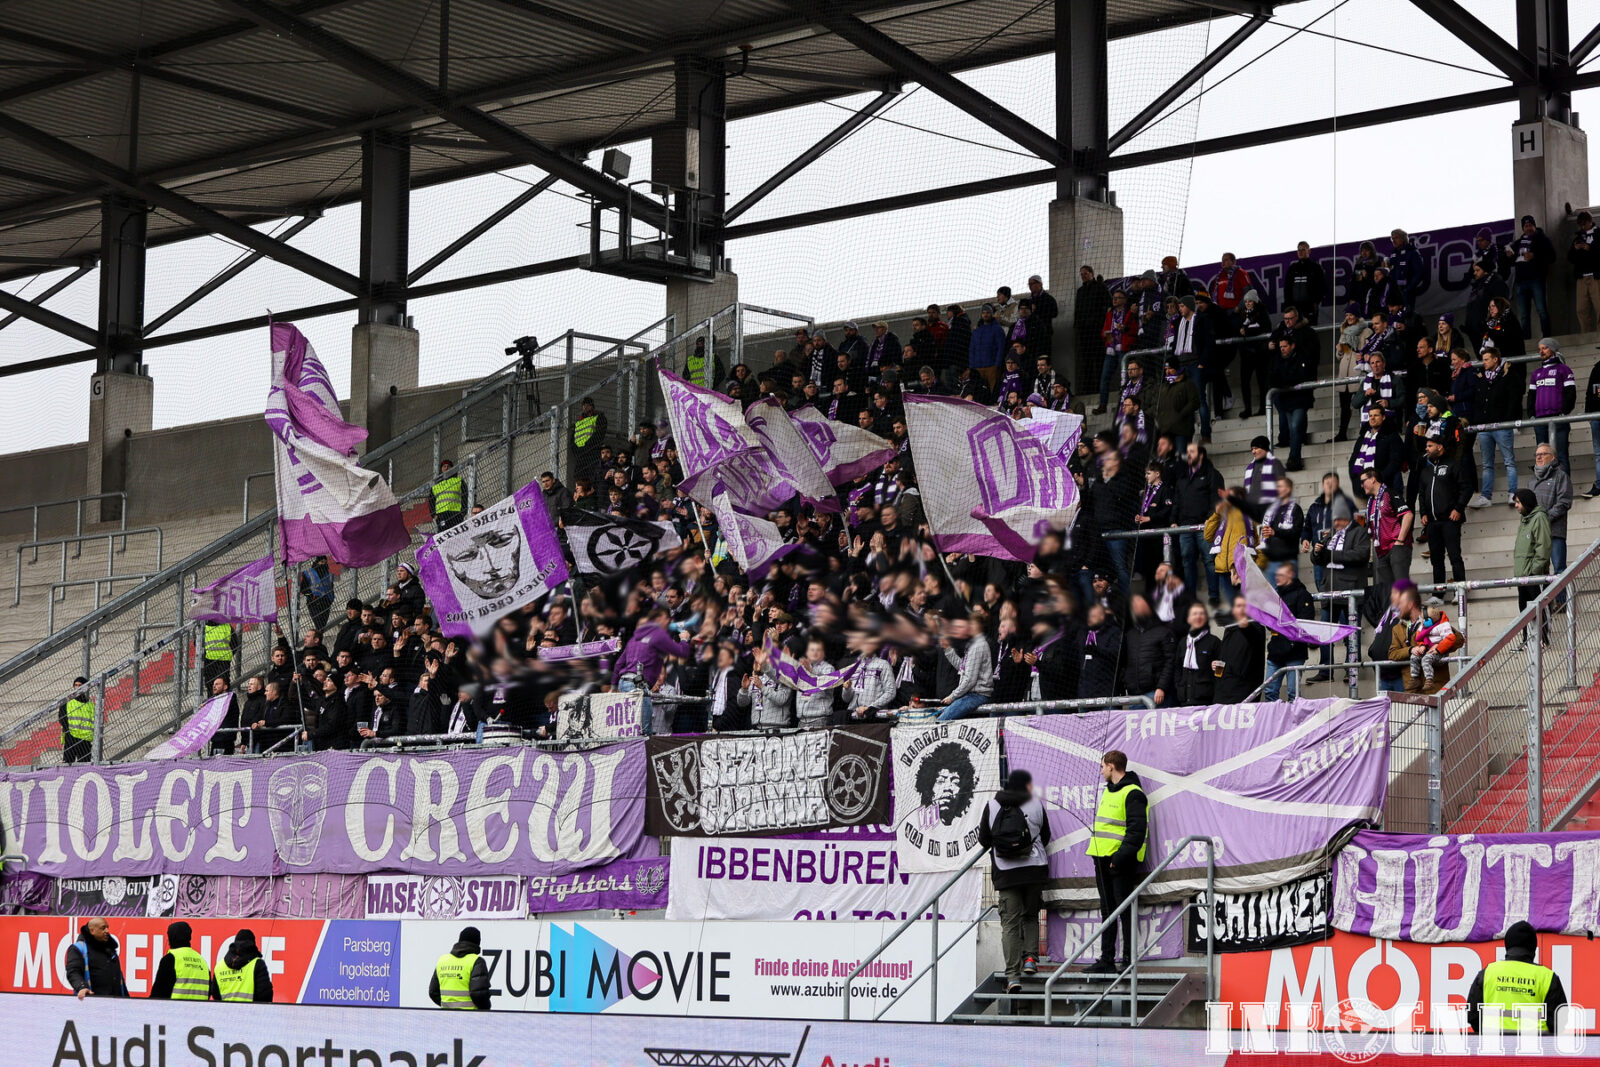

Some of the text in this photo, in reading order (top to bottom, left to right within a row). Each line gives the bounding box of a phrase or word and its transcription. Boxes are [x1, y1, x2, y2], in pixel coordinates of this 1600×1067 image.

[1520, 130, 1535, 152] H
[93, 380, 101, 395] G
[900, 724, 991, 766] PURPLE HAZE
[1283, 721, 1387, 784] BRÜCKE
[0, 749, 626, 864] VIOLET CREW
[905, 822, 924, 849] ALL
[928, 839, 941, 856] IN
[1164, 836, 1225, 864] 1989
[698, 843, 909, 885] IBBENBÜREN
[367, 882, 418, 914] HASE
[531, 875, 634, 902] Fighters
[343, 937, 391, 956] Parsberg
[340, 961, 390, 980] Ingolstadt
[587, 948, 731, 1003] MOVIE
[755, 958, 789, 976] Finde
[792, 959, 828, 977] deine
[320, 986, 390, 1002] moebelhof.de
[1262, 940, 1597, 1028] MÖBL
[52, 1019, 166, 1067] Audi
